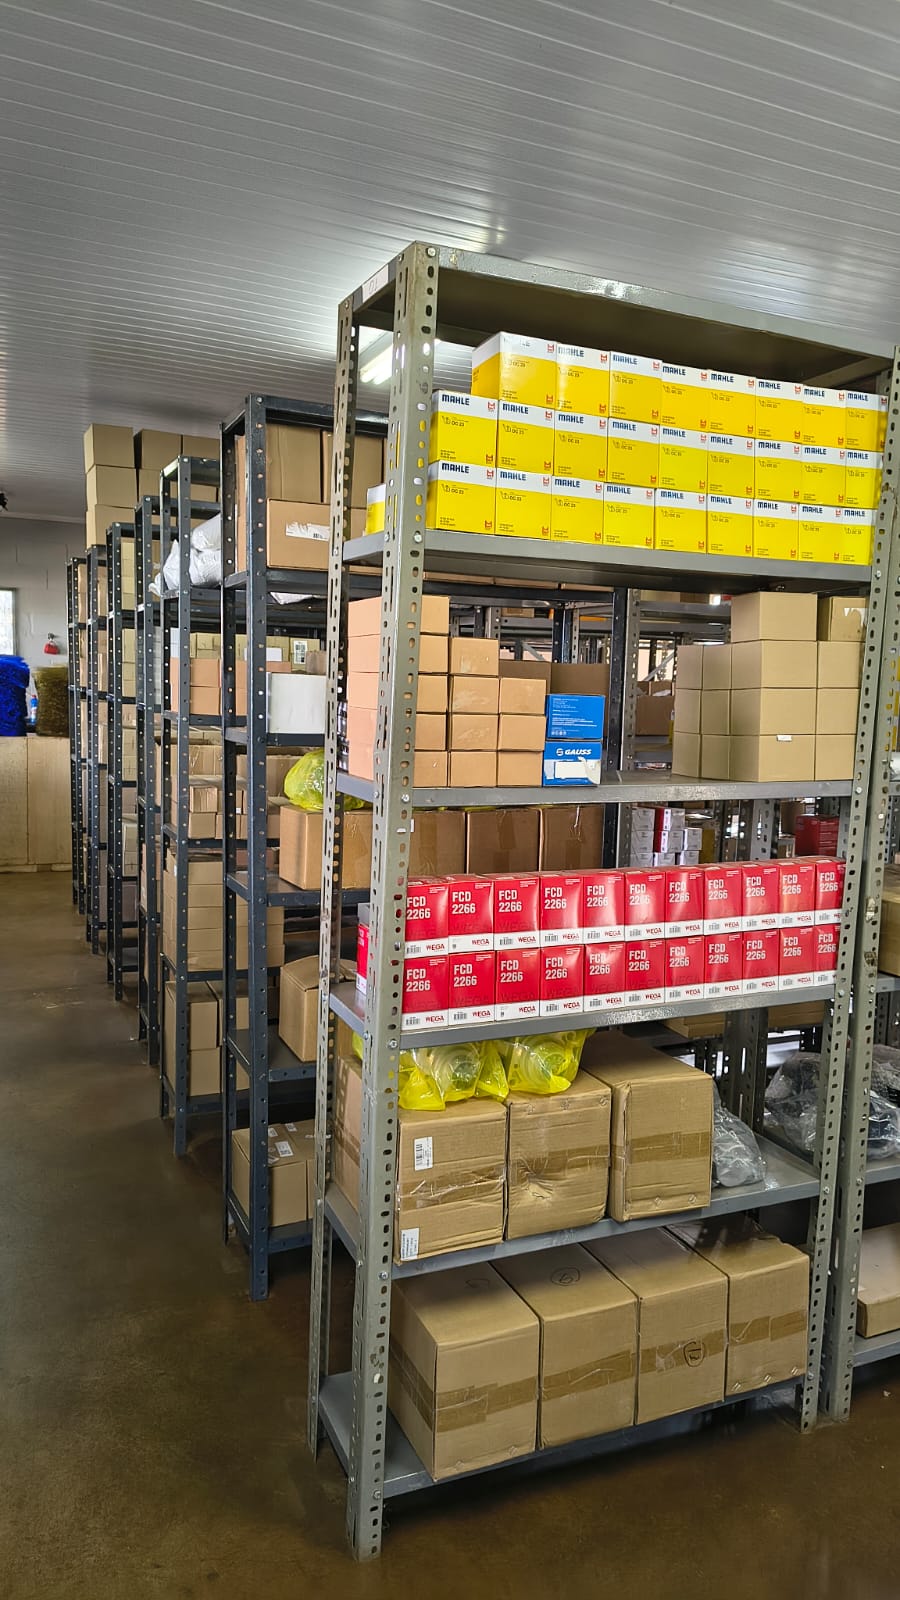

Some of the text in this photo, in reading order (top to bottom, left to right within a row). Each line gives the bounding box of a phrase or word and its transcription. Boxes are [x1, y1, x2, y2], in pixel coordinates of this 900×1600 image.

[613, 354, 637, 365] MAHLE
[662, 366, 686, 376] MAHLE
[710, 373, 734, 383] MAHLE
[758, 381, 780, 390] MAHLE
[804, 388, 824, 397] MAHLE
[847, 393, 868, 401] MAHLE
[442, 394, 469, 406] MAHLE
[503, 403, 528, 414] MAHLE
[558, 413, 584, 424] MAHLE
[612, 422, 636, 431] MAHLE
[662, 428, 685, 438] MAHLE
[710, 436, 733, 445] MAHLE
[758, 442, 781, 450] MAHLE
[804, 448, 826, 456] MAHLE
[847, 451, 868, 459] MAHLE
[442, 463, 469, 473] MAHLE
[500, 471, 526, 481] MAHLE
[555, 478, 580, 488] MAHLE
[607, 485, 631, 495] MAHLE
[660, 491, 684, 500] MAHLE
[710, 496, 732, 504] MAHLE
[758, 501, 778, 510] MAHLE
[802, 506, 822, 514] MAHLE
[746, 877, 761, 886] FCD
[783, 874, 797, 884] FCD
[820, 872, 834, 882] FCD
[630, 884, 645, 893] FCD
[670, 882, 686, 892] FCD
[708, 879, 724, 889] FCD
[820, 883, 838, 892] 2266
[499, 890, 517, 900] FCD
[545, 888, 562, 897] FCD
[587, 886, 604, 896] FCD
[708, 890, 728, 900] 2266
[746, 887, 765, 897] 2266
[783, 885, 801, 895] 2266
[407, 896, 426, 907] FCD
[452, 892, 471, 902] FCD
[587, 897, 608, 906] 2266
[629, 895, 650, 905] 2266
[669, 893, 689, 903] 2266
[452, 903, 475, 914] 2266
[499, 902, 522, 912] 2266
[544, 898, 566, 909] 2266
[407, 908, 430, 919] 2266
[784, 937, 798, 946] FCD
[819, 934, 833, 943] FCD
[709, 944, 725, 953] FCD
[747, 940, 762, 950] FCD
[818, 944, 836, 953] 2266
[629, 950, 646, 960] FCD
[670, 946, 685, 956] FCD
[746, 950, 766, 960] 2266
[784, 947, 801, 956] 2266
[546, 957, 563, 967] FCD
[589, 954, 606, 963] FCD
[670, 957, 689, 967] 2266
[709, 954, 729, 964] 2266
[454, 964, 472, 974] FCD
[501, 960, 518, 970] FCD
[589, 965, 610, 975] 2266
[629, 961, 650, 971] 2266
[406, 969, 426, 979] FCD
[500, 972, 523, 983] 2266
[546, 968, 567, 979] 2266
[406, 980, 430, 991] 2266
[454, 976, 477, 987] 2266
